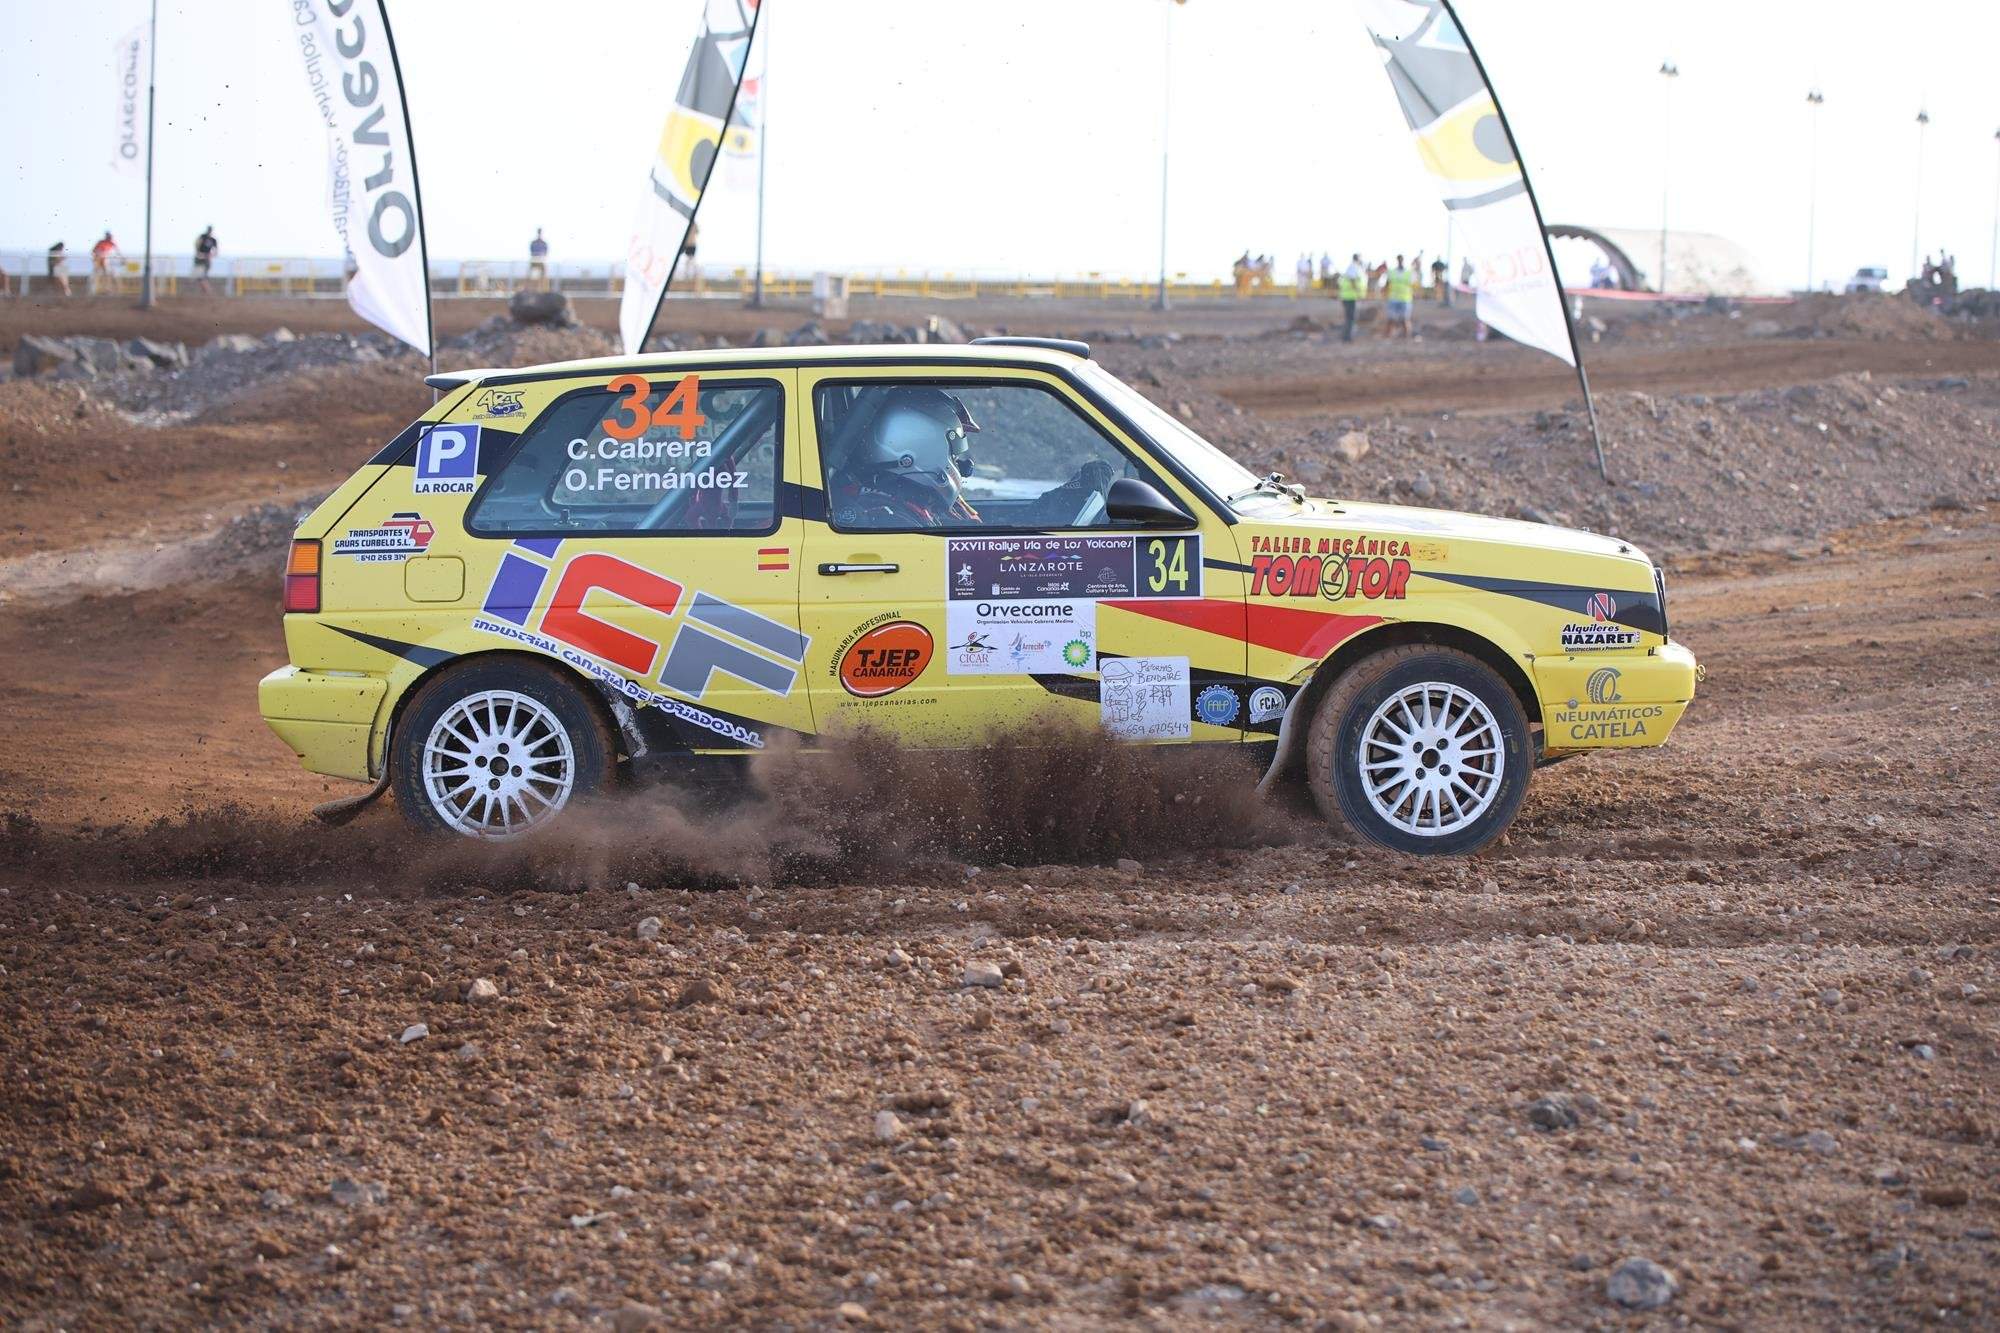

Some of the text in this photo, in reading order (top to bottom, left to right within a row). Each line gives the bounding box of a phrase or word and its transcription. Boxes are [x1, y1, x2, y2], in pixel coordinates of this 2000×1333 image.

[602, 374, 705, 440] 34
[428, 430, 467, 473] P
[567, 437, 712, 461] C.Cabrera
[565, 466, 749, 491] O.Fernández
[415, 482, 474, 493] LA ROCAR
[349, 529, 402, 537] TRANSPORTES
[361, 538, 395, 547] CURBELO
[397, 538, 411, 547] S.L.
[951, 539, 1132, 552] XXVII Rallye Isla de Los Volcanes
[1252, 536, 1311, 553] TALLER
[1317, 535, 1411, 557] MECÁNICA
[1000, 562, 1083, 572] LANZAROTE
[1149, 539, 1188, 592] 34
[977, 603, 1073, 617] Orvecame
[1080, 629, 1091, 639] bp
[1563, 623, 1619, 634] Alquileres
[829, 610, 902, 677] MAQUINARIA PROFESIONAL
[1562, 633, 1634, 645] NAZARET
[858, 649, 920, 667] TJEP
[959, 653, 989, 663] CICAR
[853, 667, 915, 677] CANARIAS
[627, 684, 648, 699] DE
[840, 698, 938, 707] www.tjepcanarias.com
[1555, 705, 1663, 723] NEUMÁTICOS
[1570, 720, 1647, 740] CATELA
